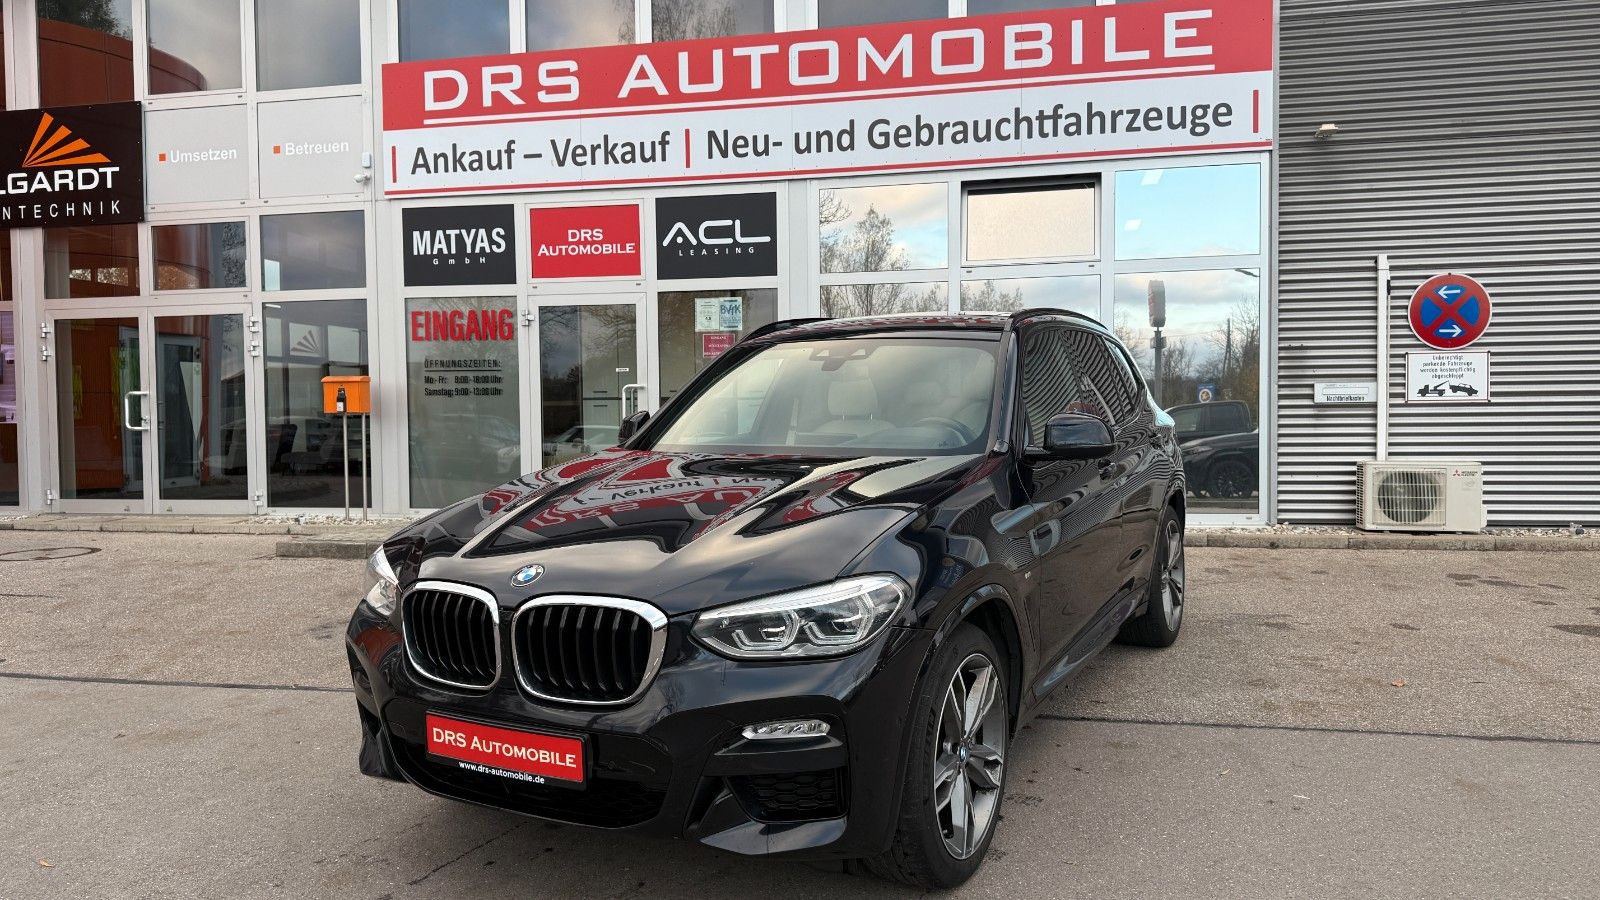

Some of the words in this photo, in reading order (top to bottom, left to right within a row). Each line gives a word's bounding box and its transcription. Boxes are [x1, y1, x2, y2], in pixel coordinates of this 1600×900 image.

[424, 60, 580, 112] DRS
[617, 9, 1213, 99] AUTOMOBILE
[285, 142, 349, 156] Betreuen
[411, 140, 516, 175] Ankauf
[550, 130, 671, 167] Verkauf
[707, 129, 783, 160] Neu-
[794, 118, 855, 155] und
[867, 101, 1233, 150] Gebrauchtfahrzeuge
[170, 148, 237, 163] Umsetzen
[2, 200, 120, 220] NTECHNIK
[412, 227, 506, 255] MATYAS
[567, 228, 604, 242] DRS
[662, 219, 772, 247] ACL
[537, 243, 636, 257] AUTOMOBILE
[678, 246, 755, 256] LEASING
[411, 309, 514, 341] EINGANG
[432, 727, 467, 748] DRS
[470, 735, 577, 768] AUTOMOBILE
[458, 761, 545, 784] www.drs-automobile.de
